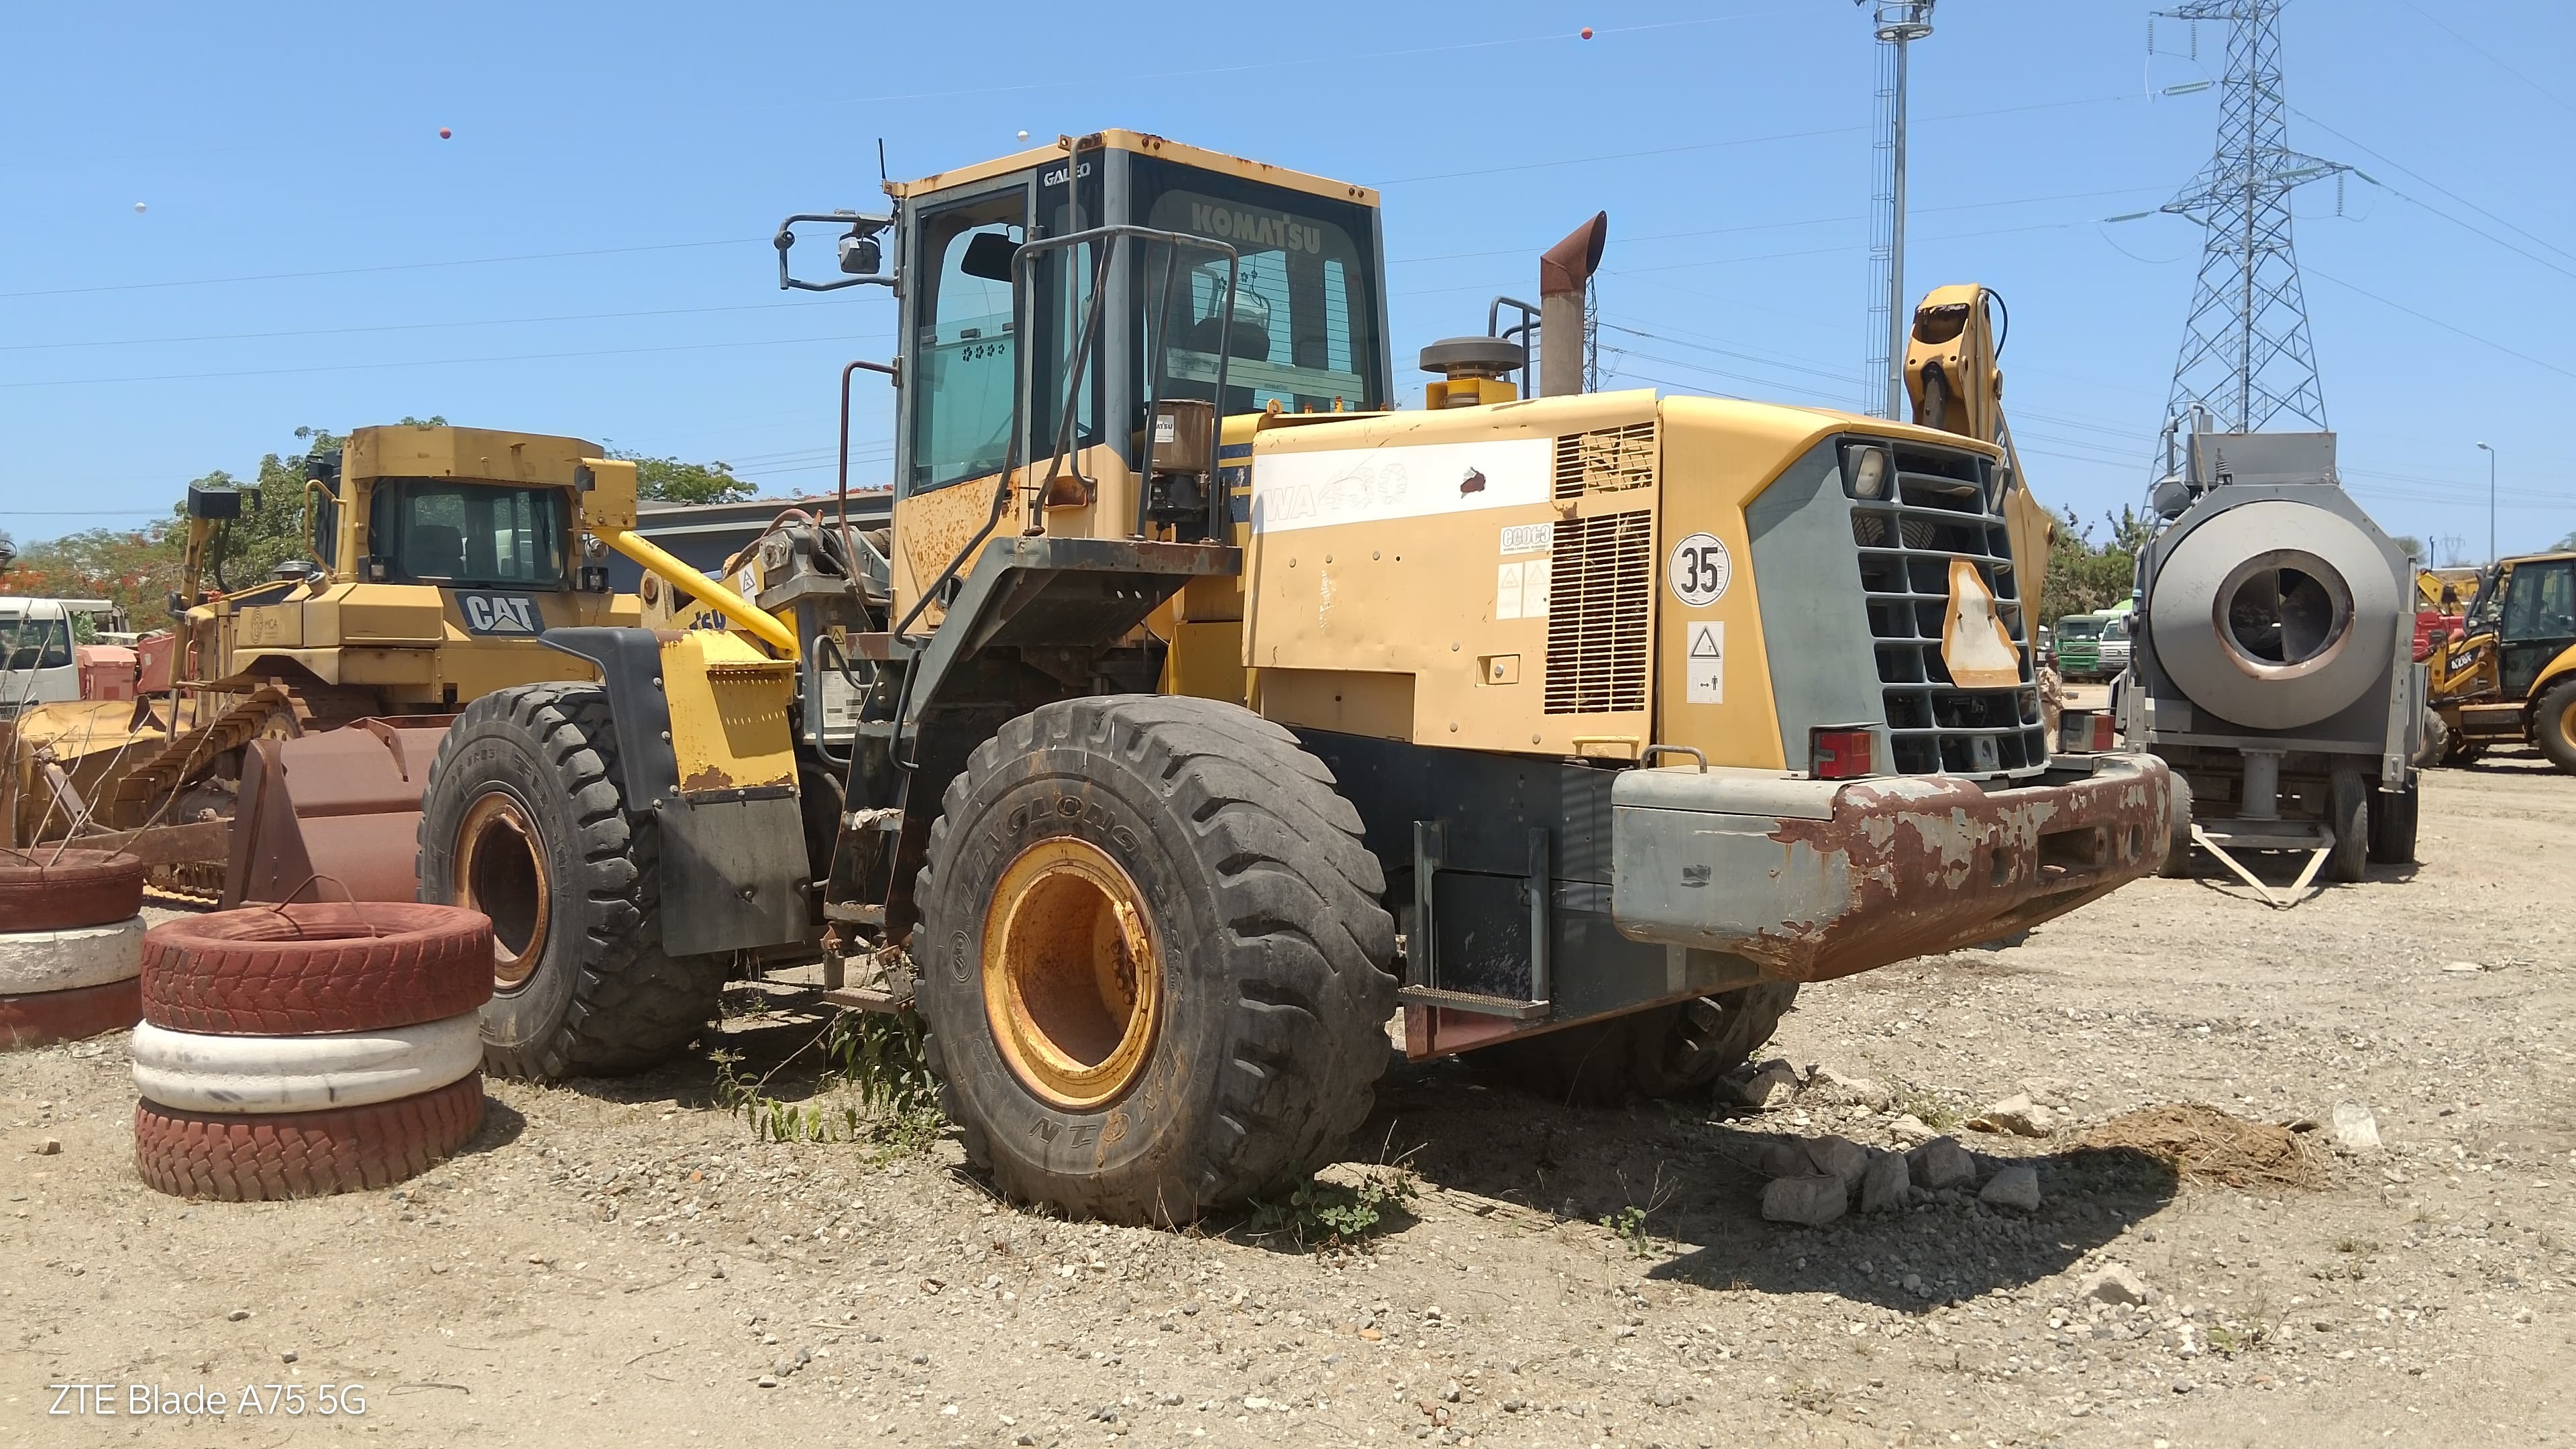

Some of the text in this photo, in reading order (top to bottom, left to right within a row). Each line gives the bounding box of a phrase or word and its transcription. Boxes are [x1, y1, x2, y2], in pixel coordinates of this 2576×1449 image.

[1191, 203, 1321, 254] KOMATSU
[1503, 525, 1550, 547] ecot3
[1680, 547, 1719, 593] 35
[466, 596, 535, 631] CAT
[2451, 651, 2472, 669] 428F
[961, 795, 1142, 916] LINGLONG
